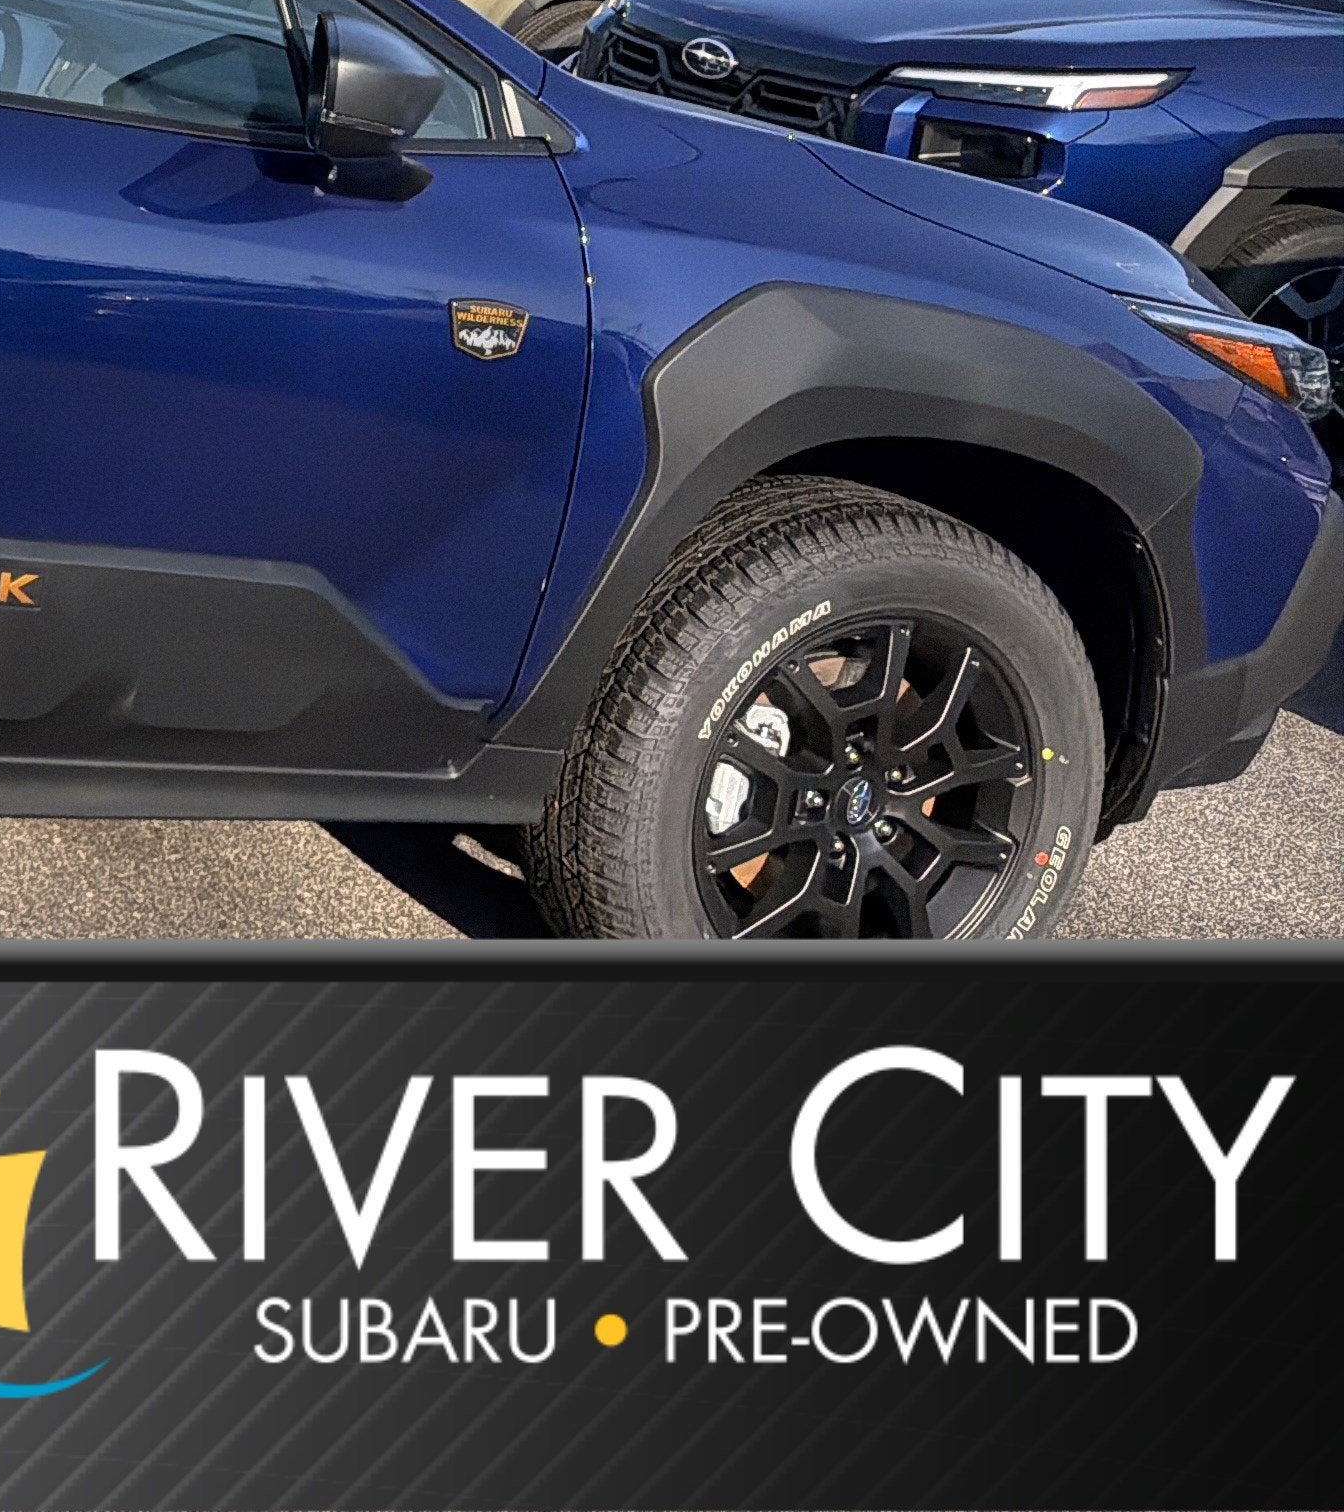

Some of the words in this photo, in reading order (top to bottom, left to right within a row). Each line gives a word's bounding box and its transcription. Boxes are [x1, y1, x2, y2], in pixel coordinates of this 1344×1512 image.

[456, 311, 524, 328] WILDERNESS
[469, 305, 514, 318] SUBARU
[697, 599, 831, 740] YOKOHAMA
